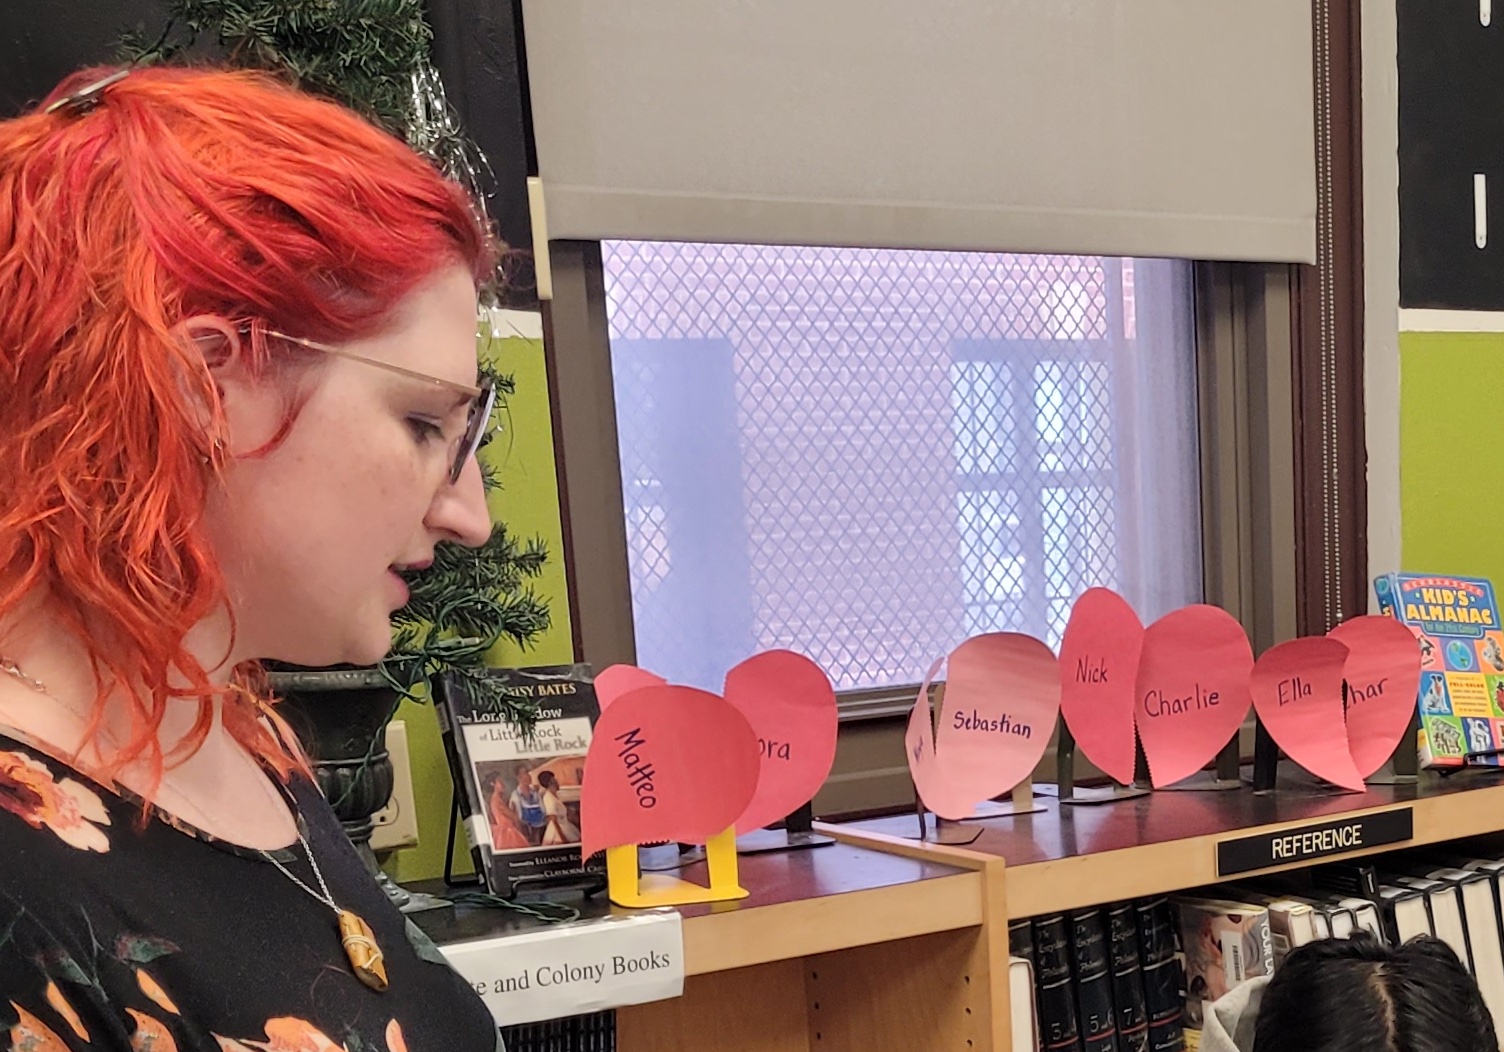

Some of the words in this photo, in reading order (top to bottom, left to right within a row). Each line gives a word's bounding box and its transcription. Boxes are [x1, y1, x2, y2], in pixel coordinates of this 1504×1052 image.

[1421, 588, 1469, 606] KID'S
[1406, 604, 1493, 625] ALMANAC
[1076, 655, 1108, 683] Nick
[538, 683, 577, 697] BATES
[1144, 683, 1219, 717] Charlie
[1278, 677, 1312, 707] Ella
[1346, 678, 1388, 709] har
[953, 709, 1031, 739] Sebastian
[554, 736, 587, 751] Rock
[615, 728, 657, 808] Matteo
[1272, 824, 1362, 859] REFERENCE
[1260, 917, 1272, 956] YOUR
[494, 970, 530, 993] and
[536, 963, 605, 984] Colony
[612, 950, 670, 975] Books
[1264, 958, 1274, 975] LA
